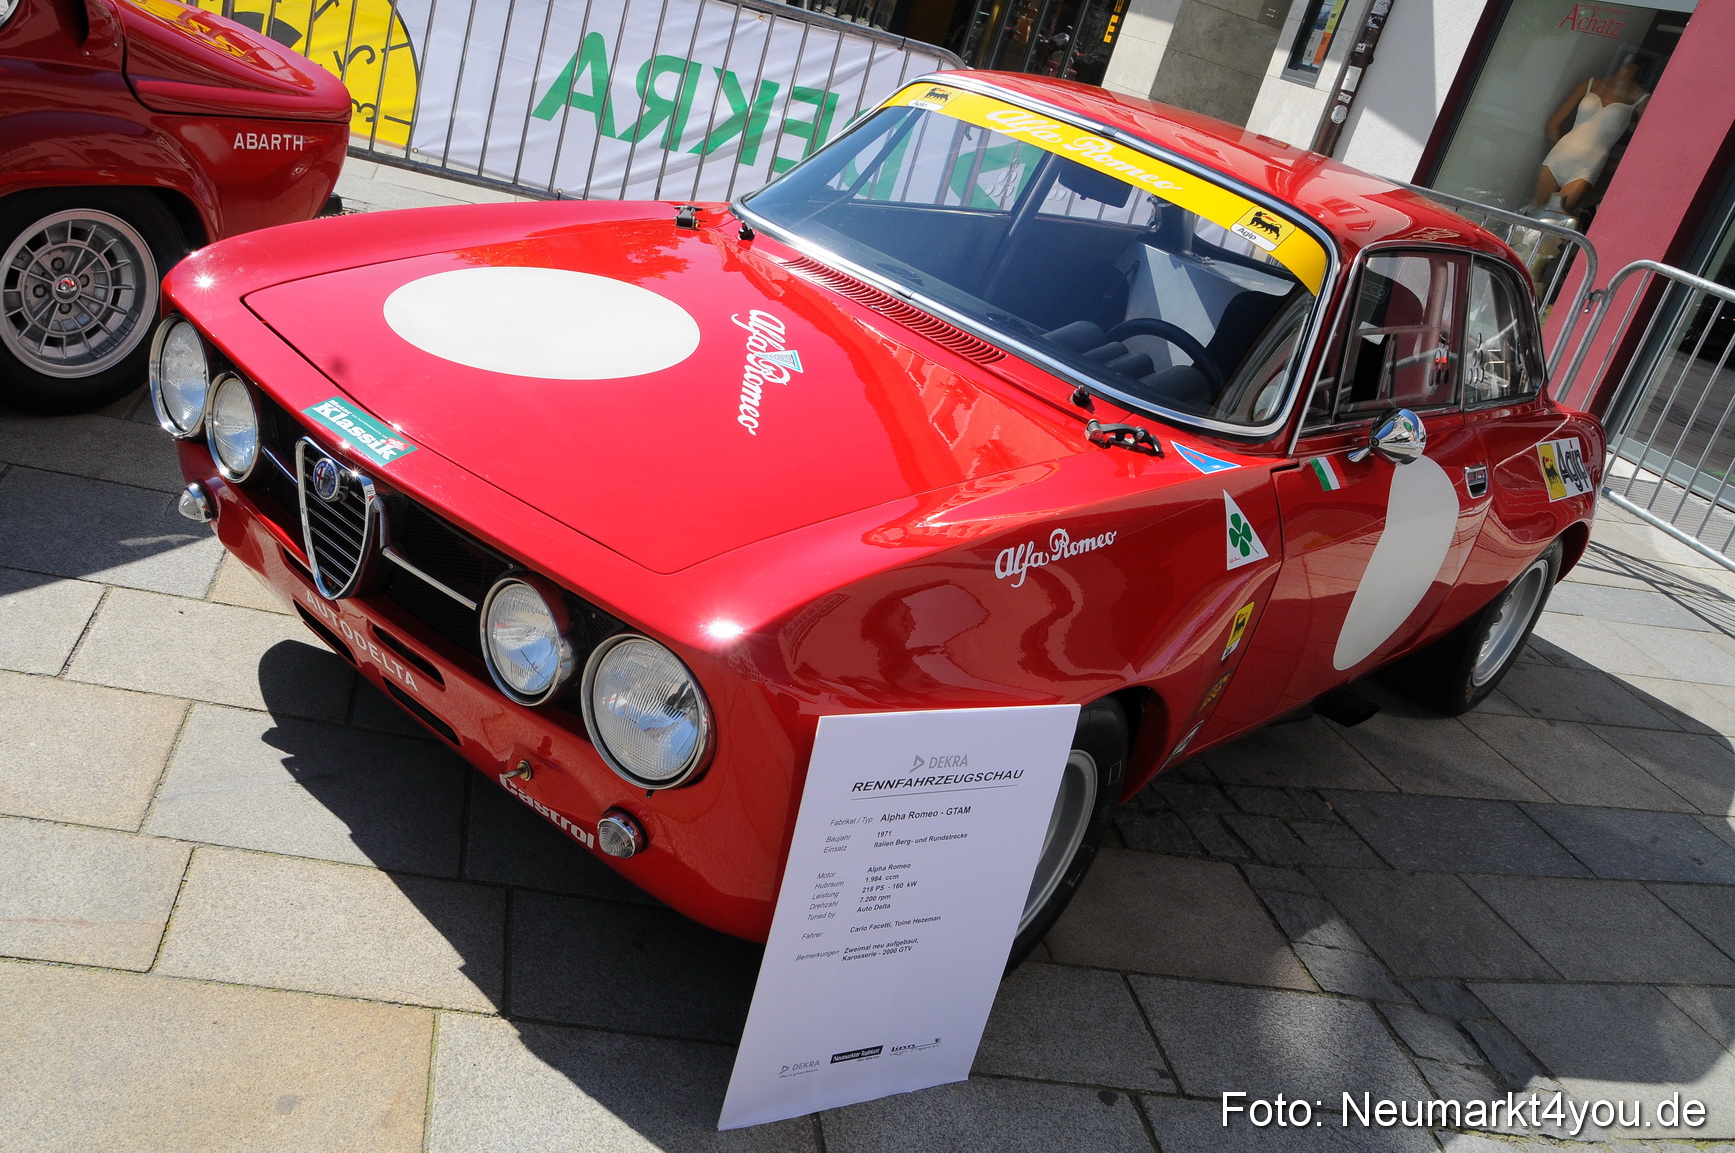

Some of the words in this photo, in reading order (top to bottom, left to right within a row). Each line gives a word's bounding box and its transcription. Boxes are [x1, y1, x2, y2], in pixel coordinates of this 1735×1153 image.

[1559, 3, 1626, 36] Achatz
[233, 132, 304, 151] ABARTH
[985, 110, 1063, 144] Alfa
[1063, 136, 1184, 191] Romeo
[1237, 227, 1257, 241] Agip
[731, 309, 786, 354] Alfa
[737, 353, 791, 436] Romeo
[312, 401, 397, 460] Klassik
[1555, 439, 1590, 492] Agip
[995, 541, 1049, 588] Alfa
[1050, 528, 1117, 561] Romeo
[306, 589, 418, 692] AUTODELTA
[928, 755, 968, 769] DEKRA
[851, 769, 1024, 792] RENNFAHRZEUGSCHAU
[499, 773, 594, 850] Castrol
[880, 811, 906, 823] Alpha
[908, 810, 938, 820] Romeo
[946, 806, 971, 816] GTAM
[829, 817, 857, 827] Fabrikat
[862, 816, 873, 826] Typ
[825, 834, 852, 843] Baujahr
[873, 840, 894, 848] Italien
[895, 838, 914, 846] Berg-
[915, 836, 928, 844] und
[928, 832, 968, 843] Rundstrecke
[877, 830, 892, 838] 1971
[823, 845, 848, 854] Einsatz
[867, 864, 887, 873] Alpha
[816, 871, 837, 880] Motor
[865, 875, 883, 883] 1.984
[885, 873, 899, 881] ccm
[814, 880, 845, 889] Hubraum
[811, 890, 840, 900] Leistung
[859, 895, 877, 903] 7.200
[877, 894, 891, 902] rpm
[809, 900, 839, 910] Drehzahl
[873, 903, 891, 911] Delta
[807, 912, 827, 921] Tuned
[828, 911, 836, 919] by
[849, 925, 868, 933] Carlo
[894, 918, 911, 927] Toine
[912, 914, 941, 924] Hezeman
[801, 931, 823, 940] Fahrer
[795, 949, 840, 961] Bemerkungen
[841, 951, 877, 962] Karosserie
[882, 947, 898, 956] 2000
[898, 945, 913, 953] GTV
[844, 944, 871, 954] Zweimal
[792, 1060, 820, 1071] DEKRA
